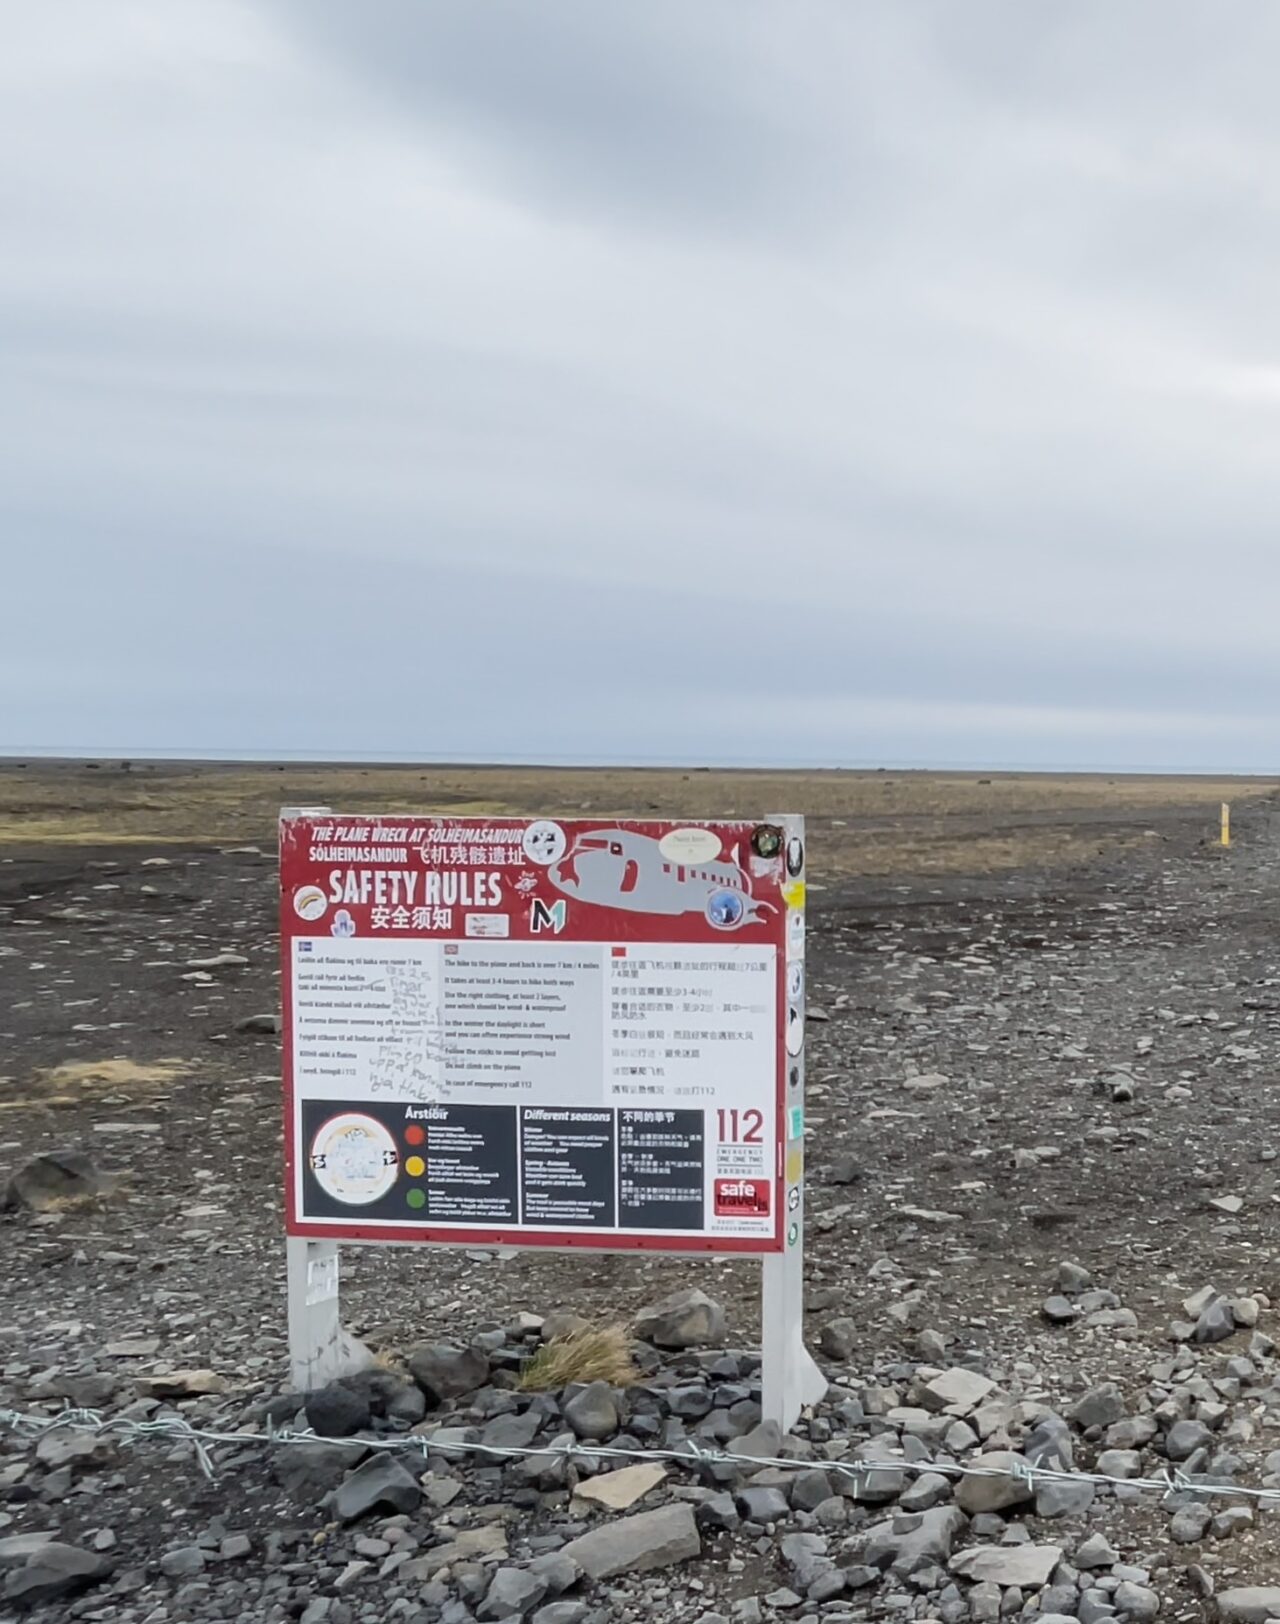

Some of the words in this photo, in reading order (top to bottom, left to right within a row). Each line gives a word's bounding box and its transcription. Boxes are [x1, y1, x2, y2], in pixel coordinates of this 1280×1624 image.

[312, 827, 333, 841] THE
[334, 827, 369, 842] PLANE
[371, 828, 408, 842] WRECK
[409, 828, 425, 843] AT
[413, 846, 526, 865] 飞机残骸遗址
[329, 870, 418, 905] SAFETY
[426, 872, 502, 906] RULES
[371, 905, 452, 930] 安全须知
[524, 1109, 570, 1122] Different
[570, 1111, 611, 1122] seasons
[717, 1109, 763, 1142] 112
[720, 1180, 755, 1197] safe
